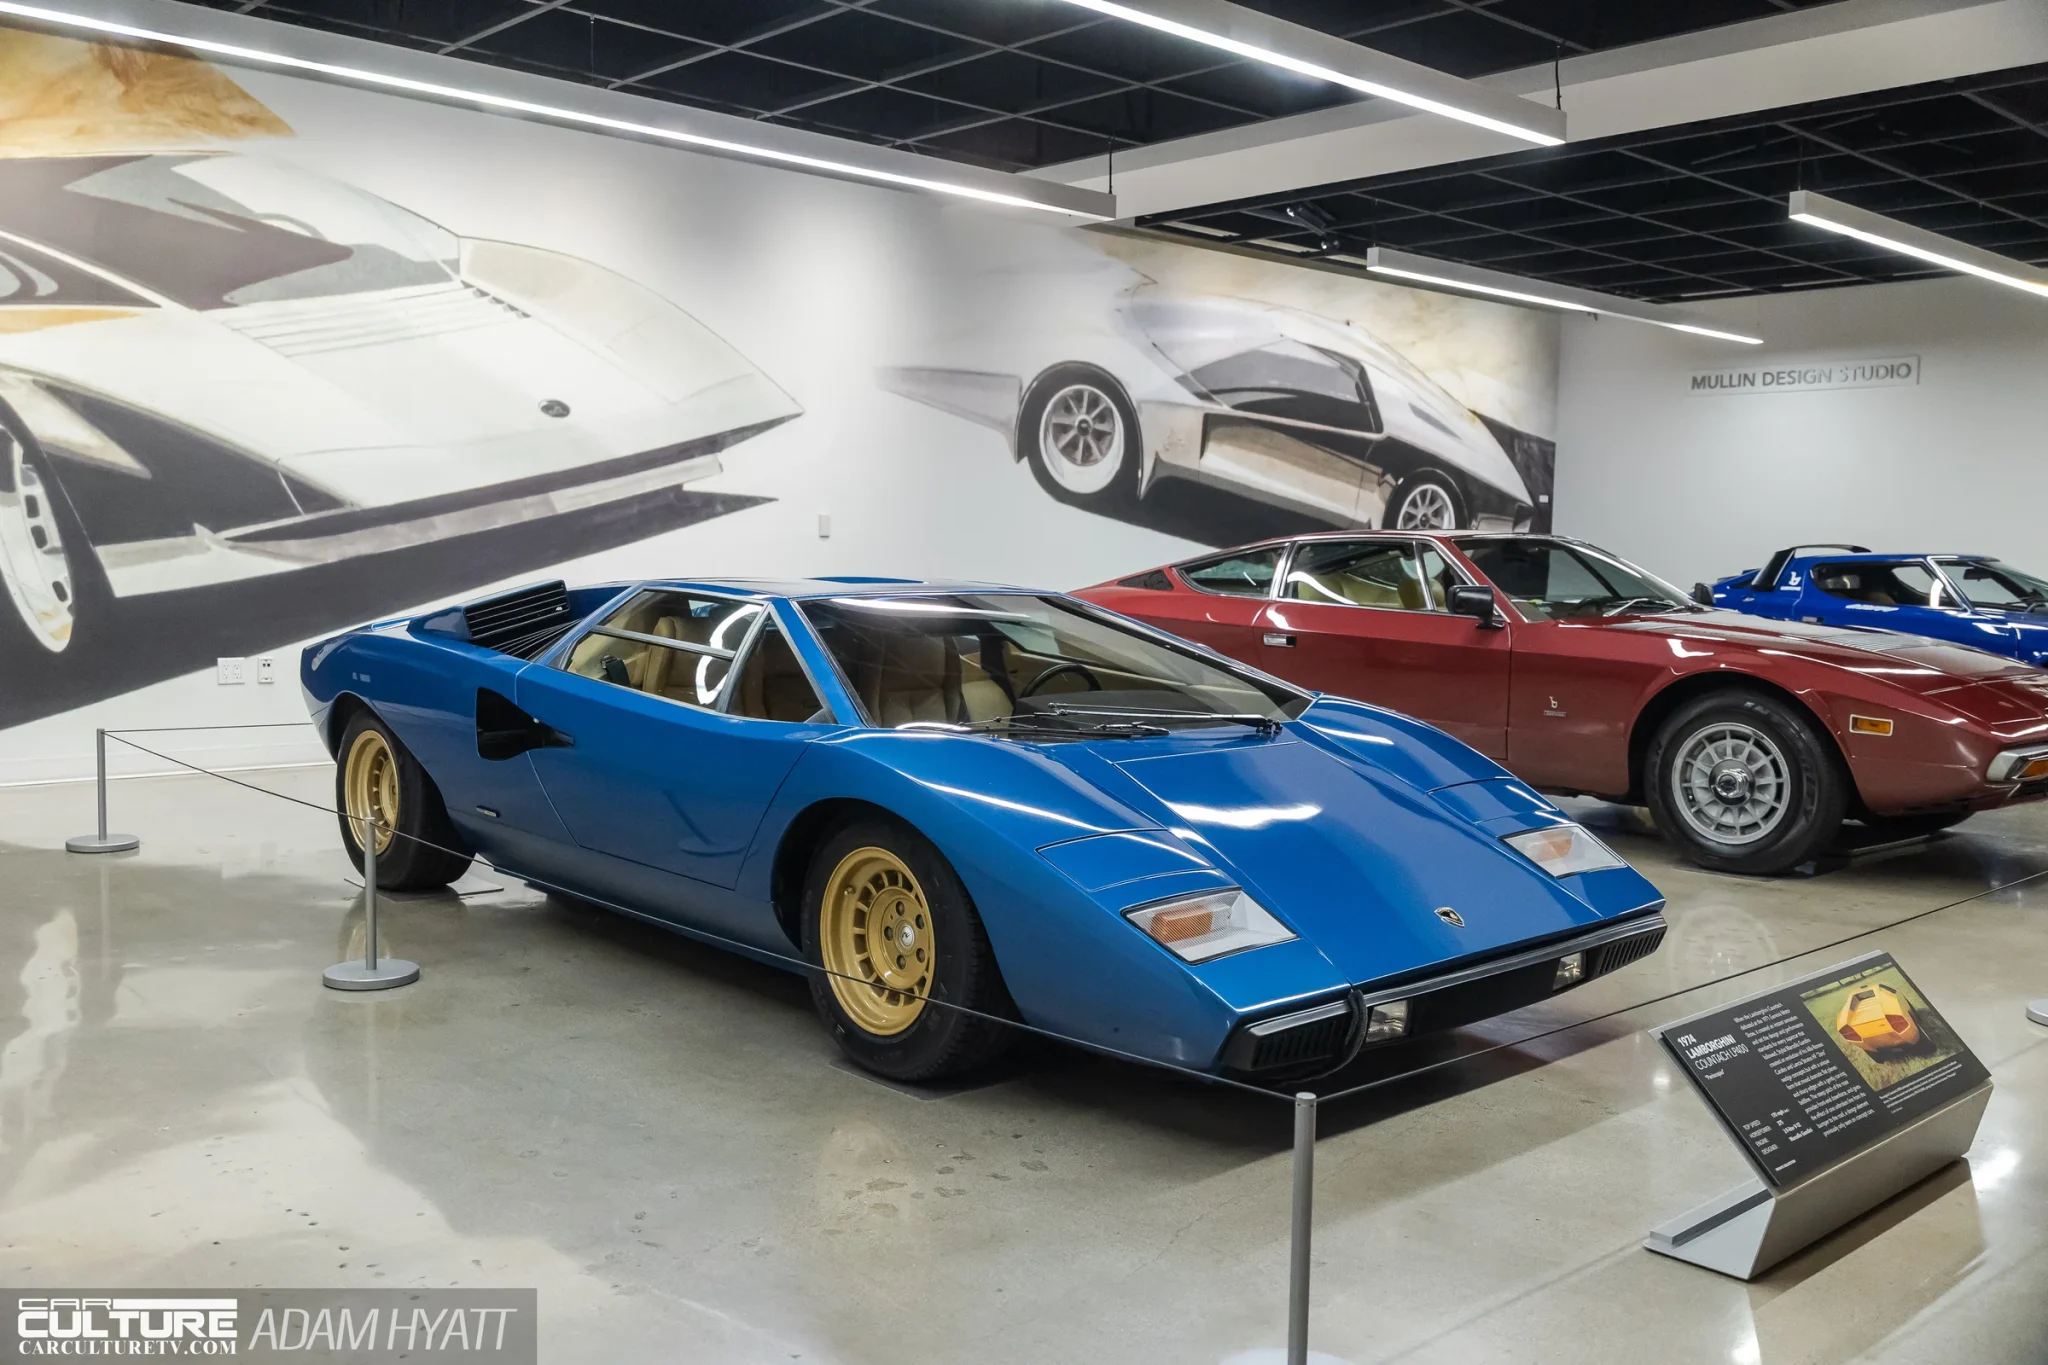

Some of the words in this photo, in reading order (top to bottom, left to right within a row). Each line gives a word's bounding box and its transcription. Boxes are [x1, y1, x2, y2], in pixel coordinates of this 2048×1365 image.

[1691, 373, 1756, 390] MULLIN
[1762, 368, 1832, 386] DESIGN
[1840, 362, 1912, 383] STUDIO
[1678, 1034, 1696, 1046] 1974
[1686, 1034, 1736, 1058] LAMBORGHINI
[1695, 1050, 1732, 1069] COUNTACH
[1729, 1044, 1748, 1056] LP400
